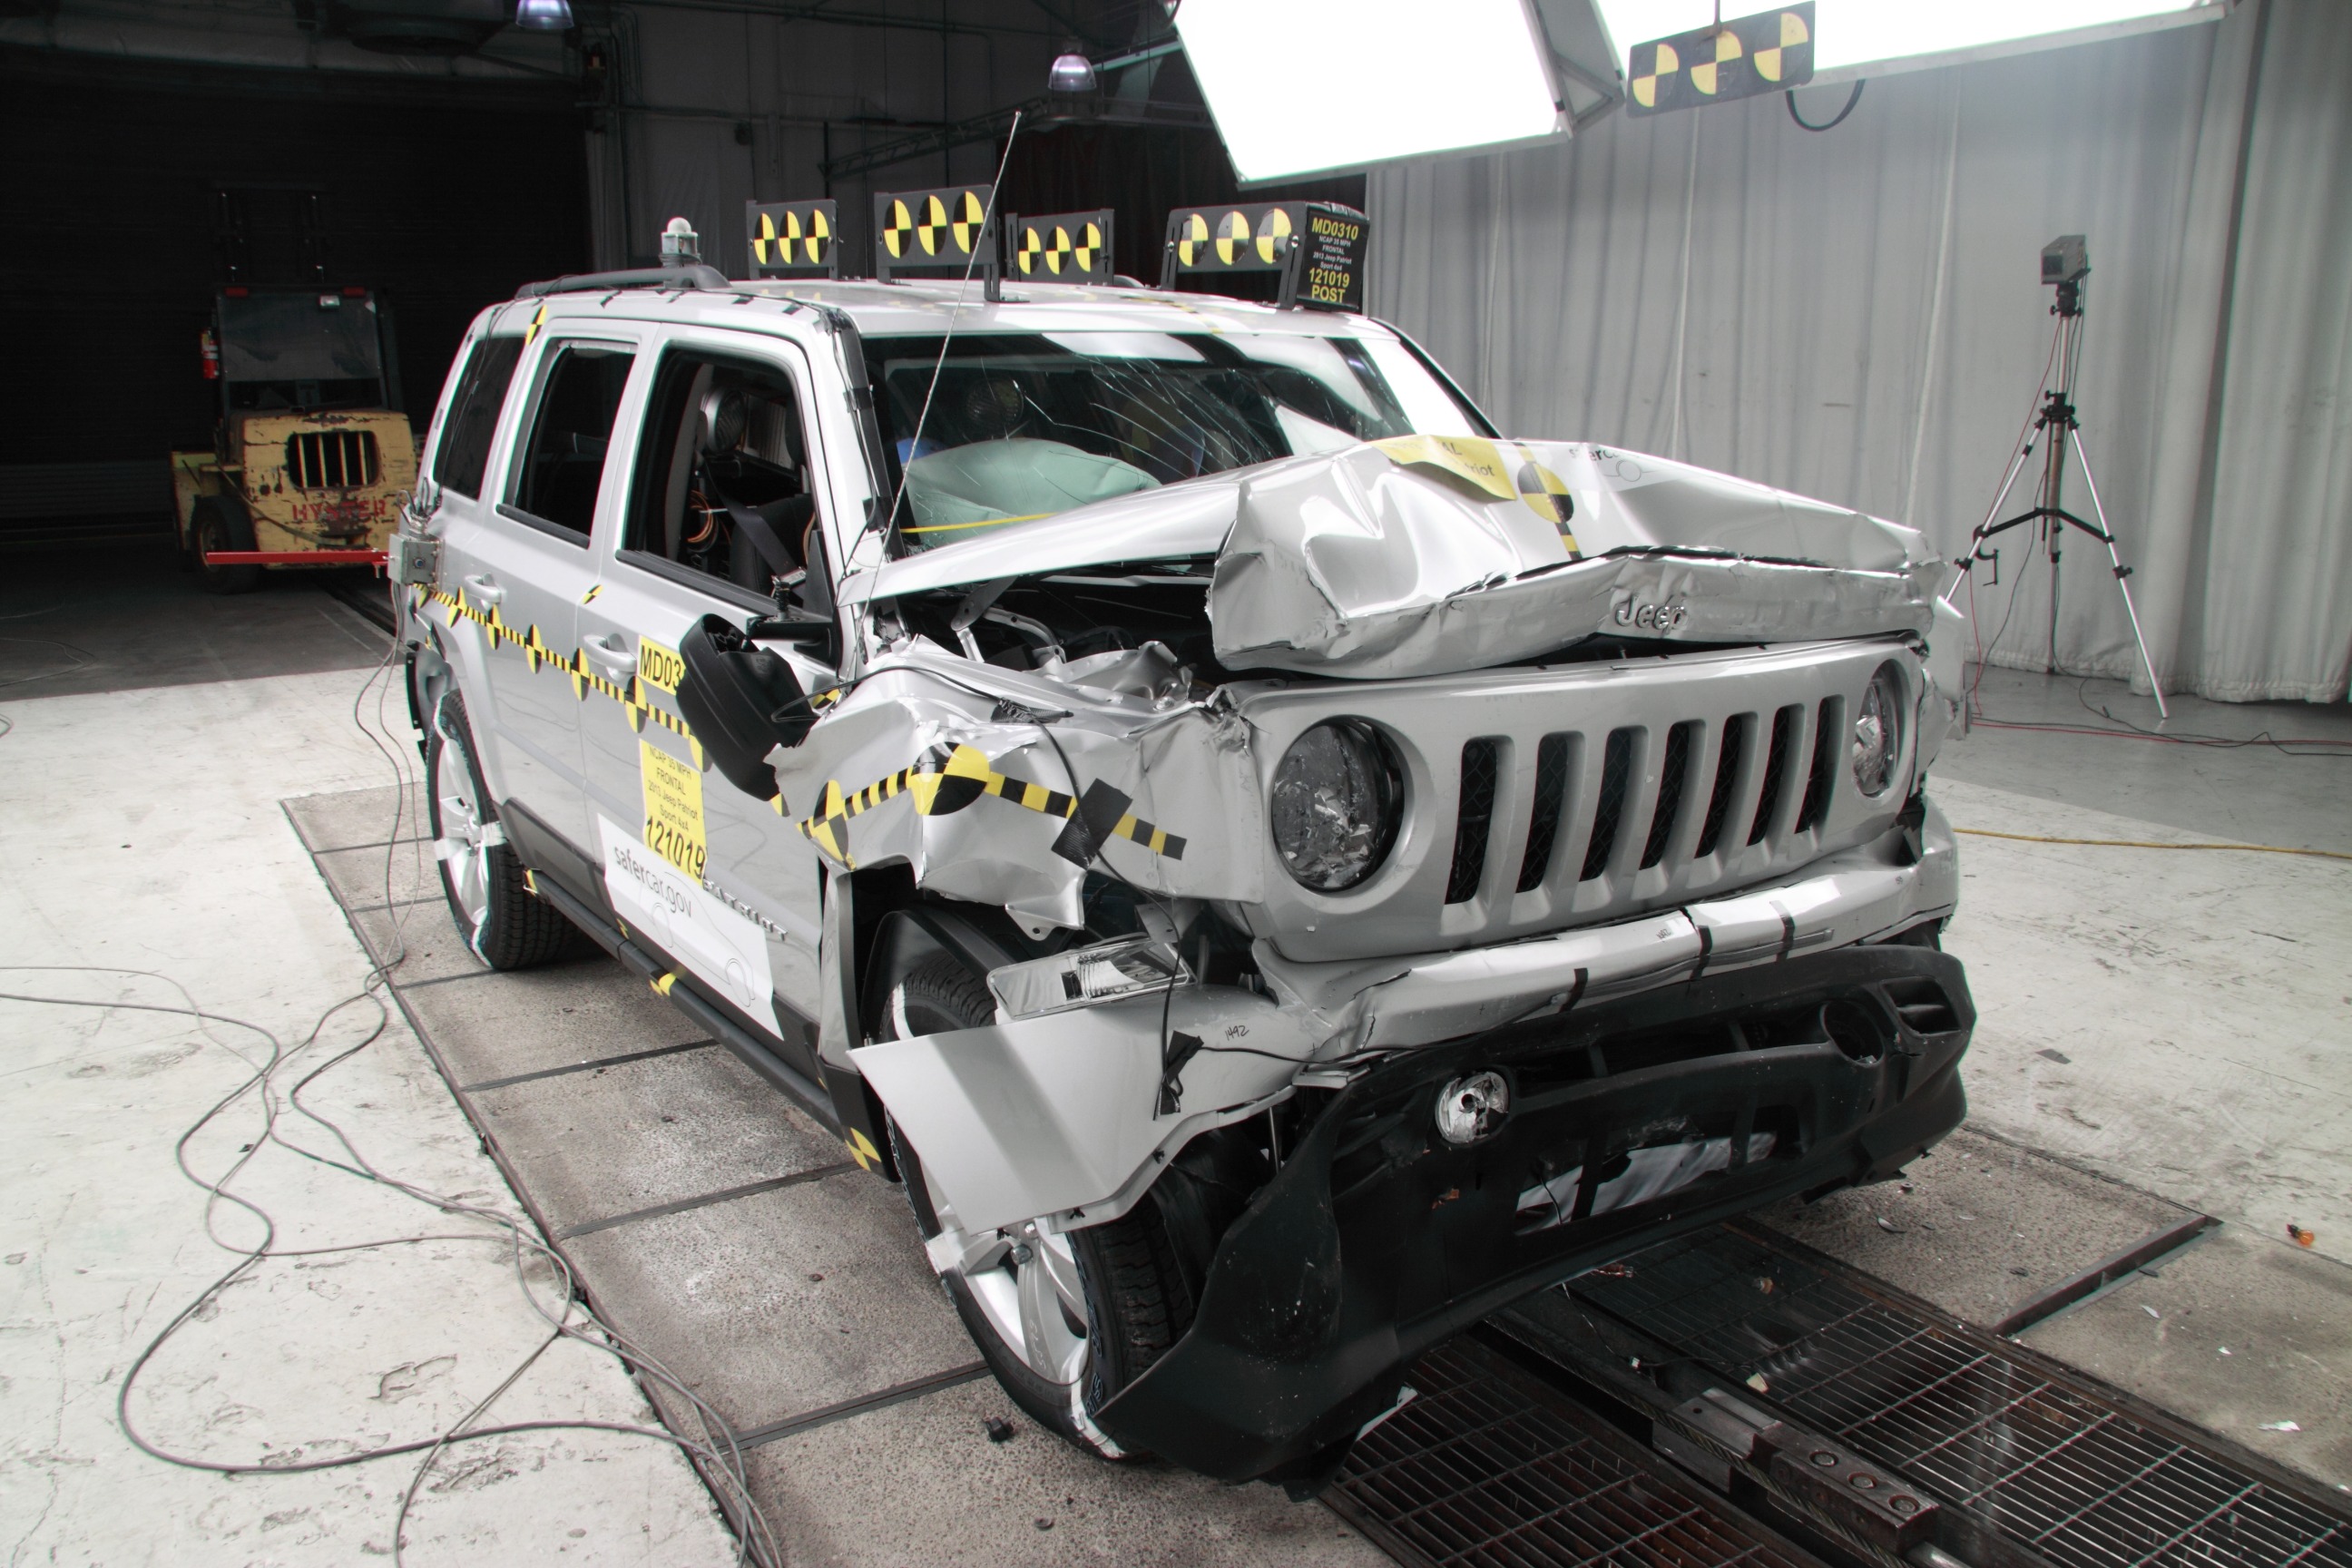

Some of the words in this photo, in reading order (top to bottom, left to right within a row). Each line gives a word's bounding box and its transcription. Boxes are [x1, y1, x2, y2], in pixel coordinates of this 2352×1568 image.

[1312, 217, 1359, 240] MD0310
[1318, 236, 1333, 244] NCAP
[1339, 240, 1351, 248] MPH
[1322, 244, 1345, 255] FRONTAL
[1319, 261, 1334, 270] Sport
[1333, 263, 1343, 271] 4x4
[1324, 253, 1337, 262] Jeep
[1336, 255, 1352, 265] Patriot
[1308, 268, 1350, 289] 121019
[1311, 284, 1346, 304] POST
[291, 499, 387, 522] HYSTER
[639, 643, 683, 691] MD03
[649, 745, 667, 763] NCAP
[676, 760, 692, 780] MPH
[656, 766, 687, 796] FRONTAL
[662, 789, 677, 809] Jeep
[677, 798, 699, 822] Patriot
[660, 803, 677, 826] Sport
[678, 816, 690, 832] 4x4
[646, 815, 707, 880] 121019
[613, 845, 692, 919] safercar.gov
[703, 877, 789, 942] PATRIOT
[1224, 1024, 1250, 1042] 1492
